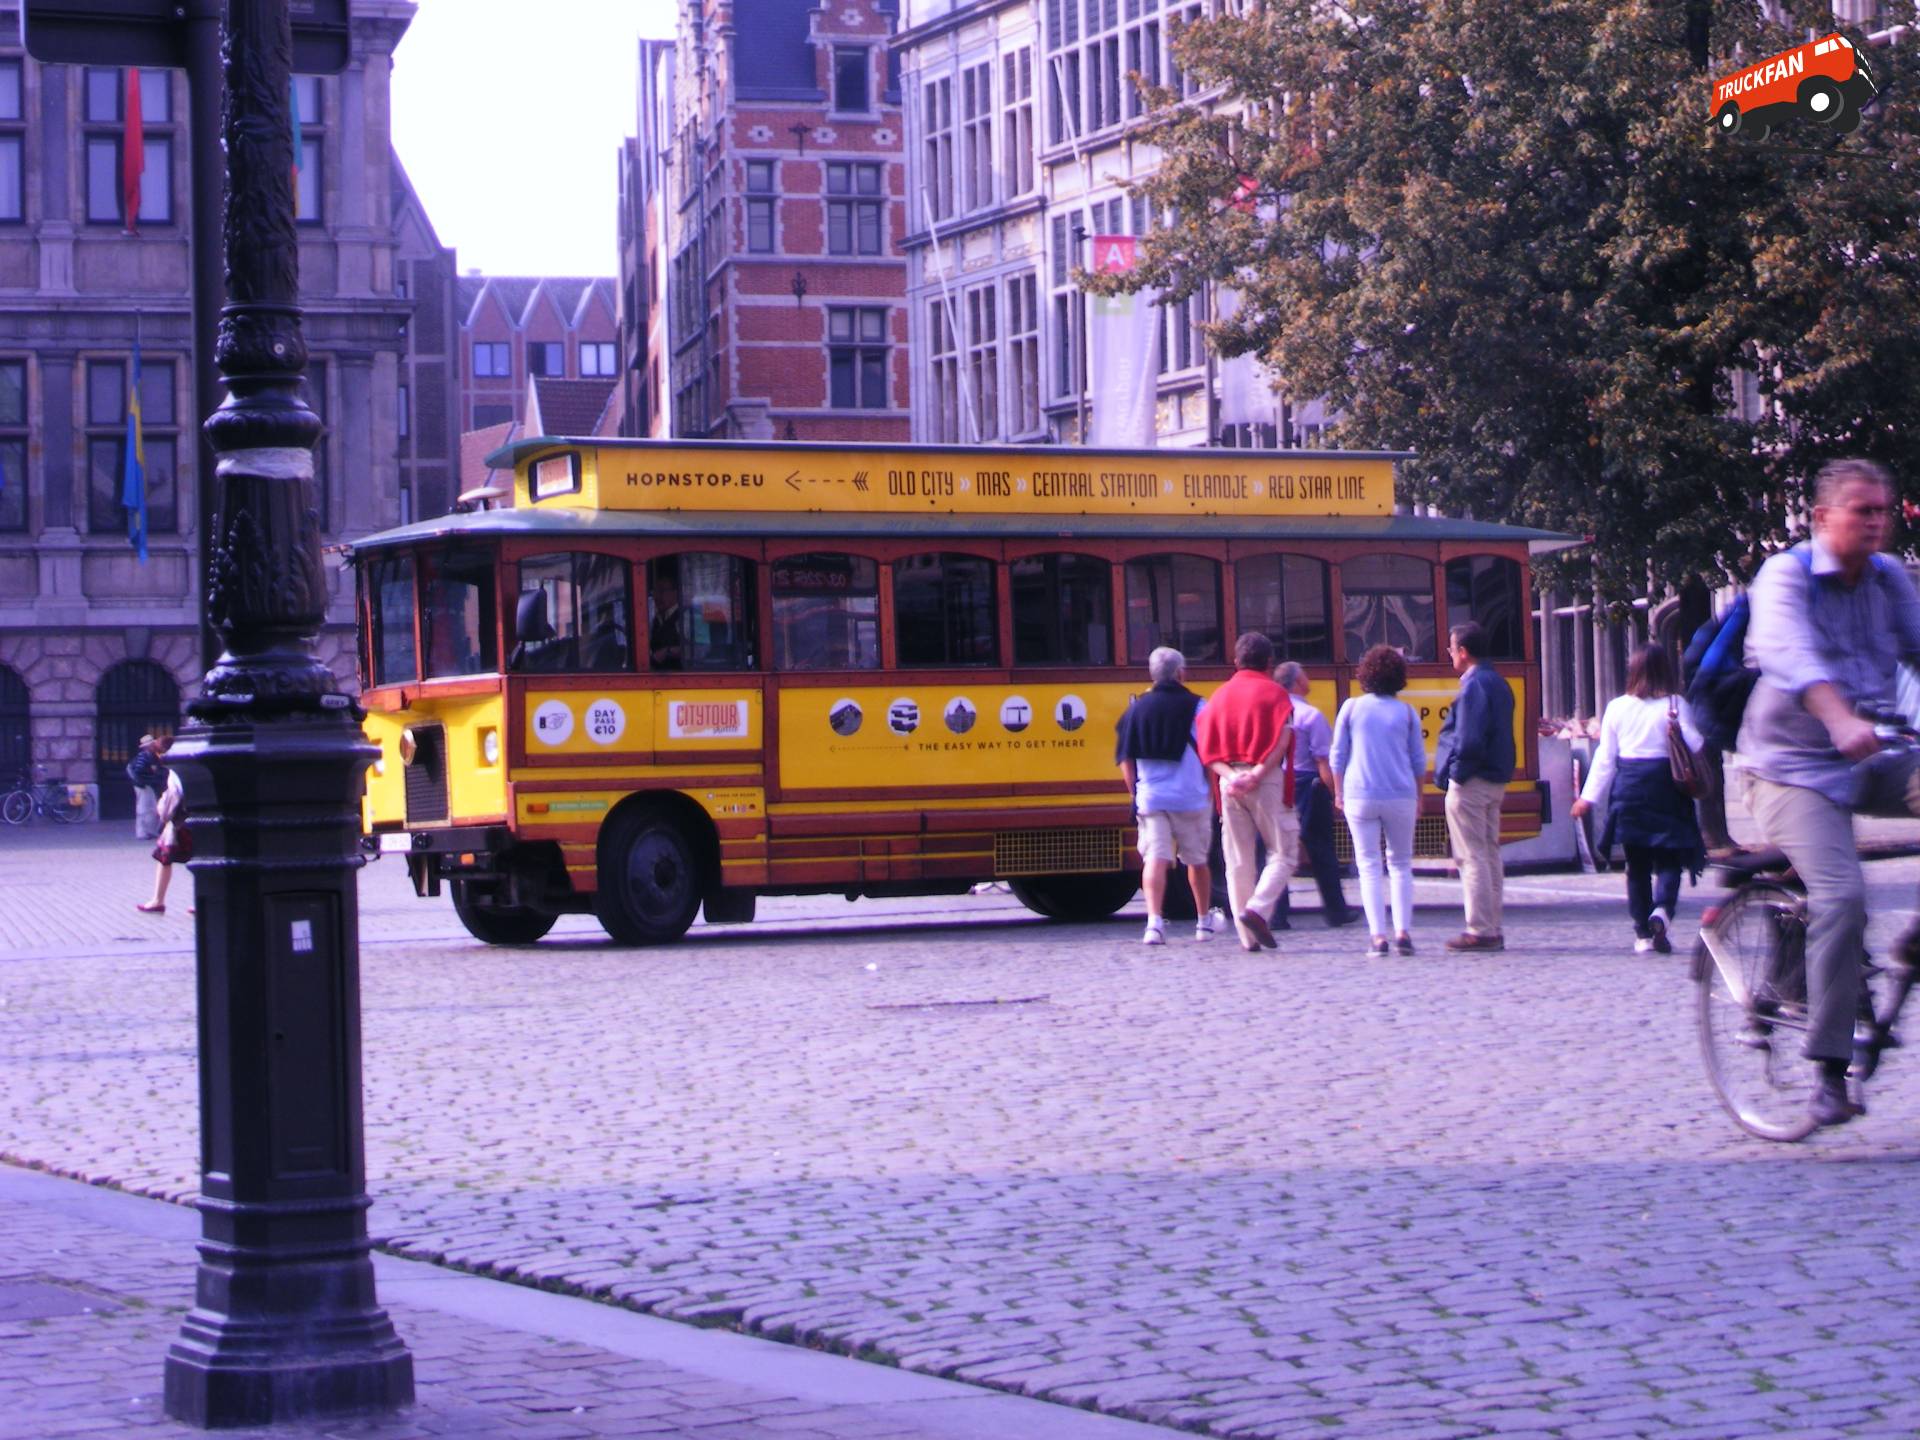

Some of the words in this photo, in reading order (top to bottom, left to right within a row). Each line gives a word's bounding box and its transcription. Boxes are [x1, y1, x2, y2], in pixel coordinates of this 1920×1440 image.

[1104, 243, 1126, 267] A
[626, 472, 765, 487] HOPNSTOP.EU
[889, 470, 915, 496] OLD
[921, 470, 954, 496] CITY
[976, 471, 1011, 497] MAS
[1033, 472, 1095, 497] CENTRAL
[1101, 472, 1158, 498] STATION
[1183, 474, 1248, 499] EILANDJE
[1269, 475, 1294, 500] RED
[1300, 475, 1332, 500] STAR
[1338, 476, 1365, 500] LINE
[594, 709, 616, 718] DAY
[676, 704, 737, 727] CITYTOUR
[594, 717, 616, 725] PASS
[594, 724, 616, 735] €10
[918, 743, 939, 751] THE
[944, 742, 972, 750] EASY
[977, 741, 1001, 750] WAY
[1007, 741, 1021, 749] TO
[1025, 740, 1046, 748] GET
[1051, 739, 1085, 748] THERE
